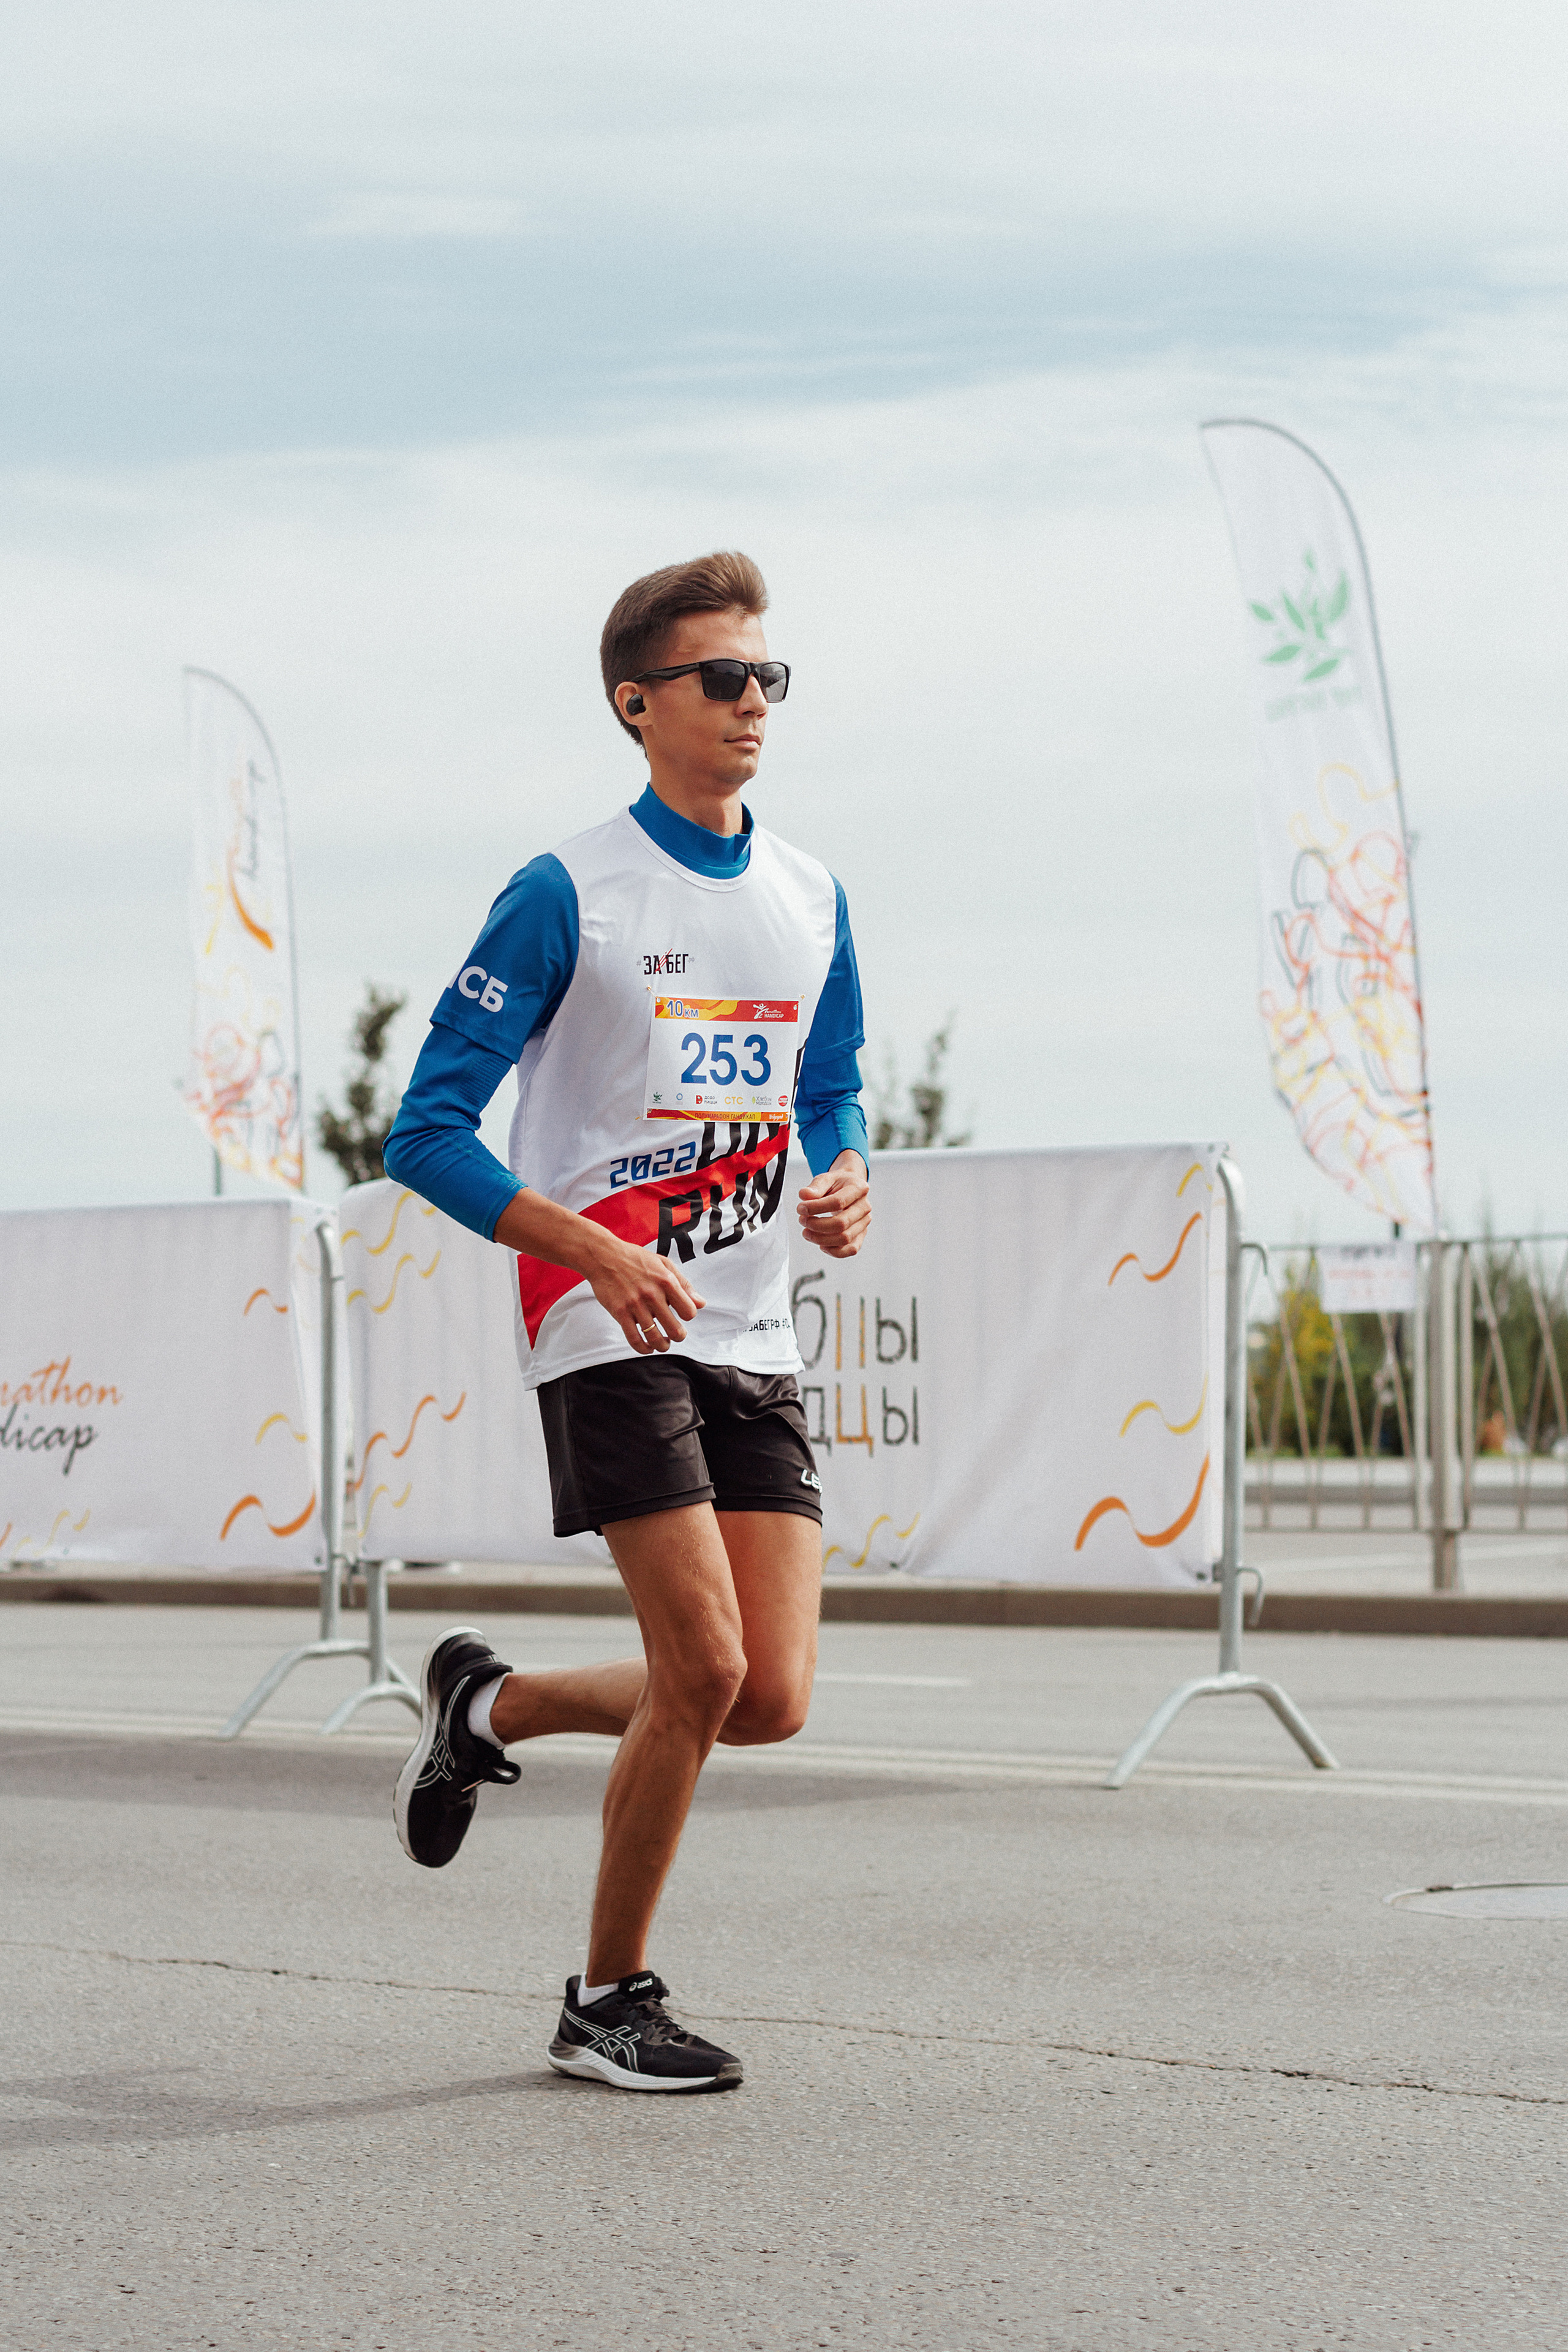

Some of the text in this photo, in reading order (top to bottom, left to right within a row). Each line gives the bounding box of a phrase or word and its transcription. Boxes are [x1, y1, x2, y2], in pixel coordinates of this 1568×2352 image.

[680, 1032, 771, 1087] 253
[610, 1141, 696, 1189] 2022
[657, 1146, 788, 1264] RUN
